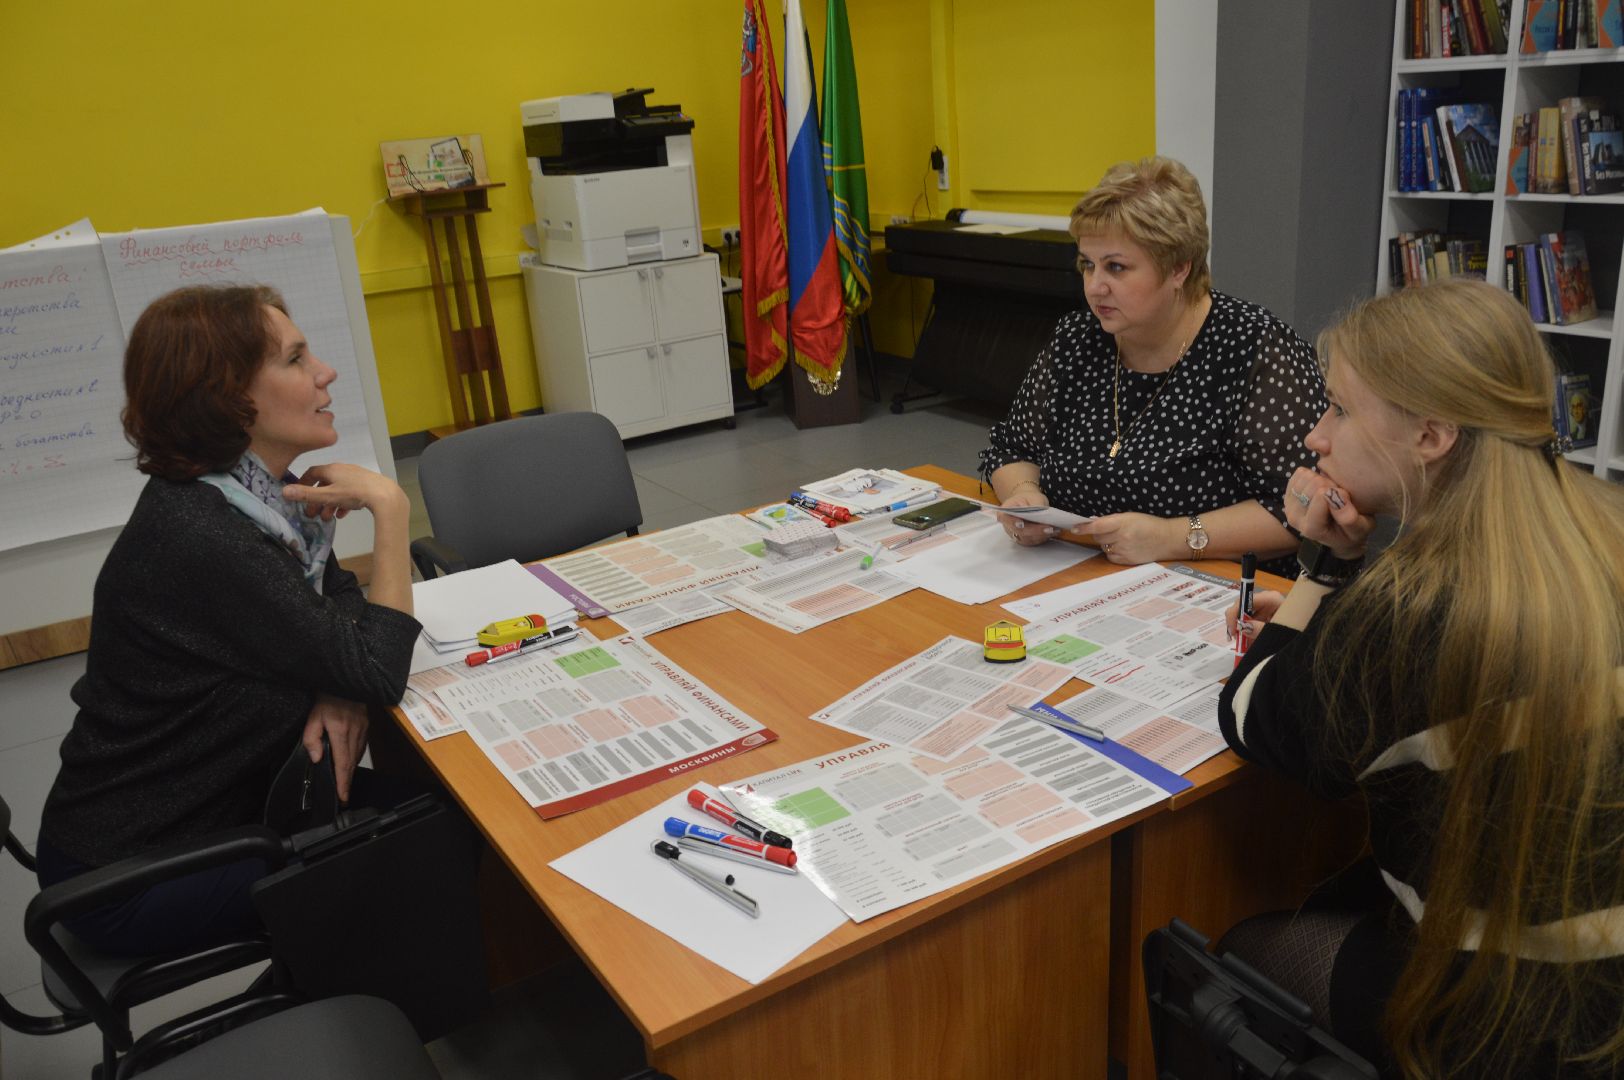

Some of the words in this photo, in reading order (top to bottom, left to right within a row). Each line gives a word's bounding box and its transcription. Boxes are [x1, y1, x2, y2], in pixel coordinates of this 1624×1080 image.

[651, 659, 696, 693] УПРАВЛЯЙ
[692, 689, 750, 732] ФИНАНСАМИ
[668, 745, 736, 774] МОСКВИНЫ
[815, 741, 891, 769] УПРАВЛЯ
